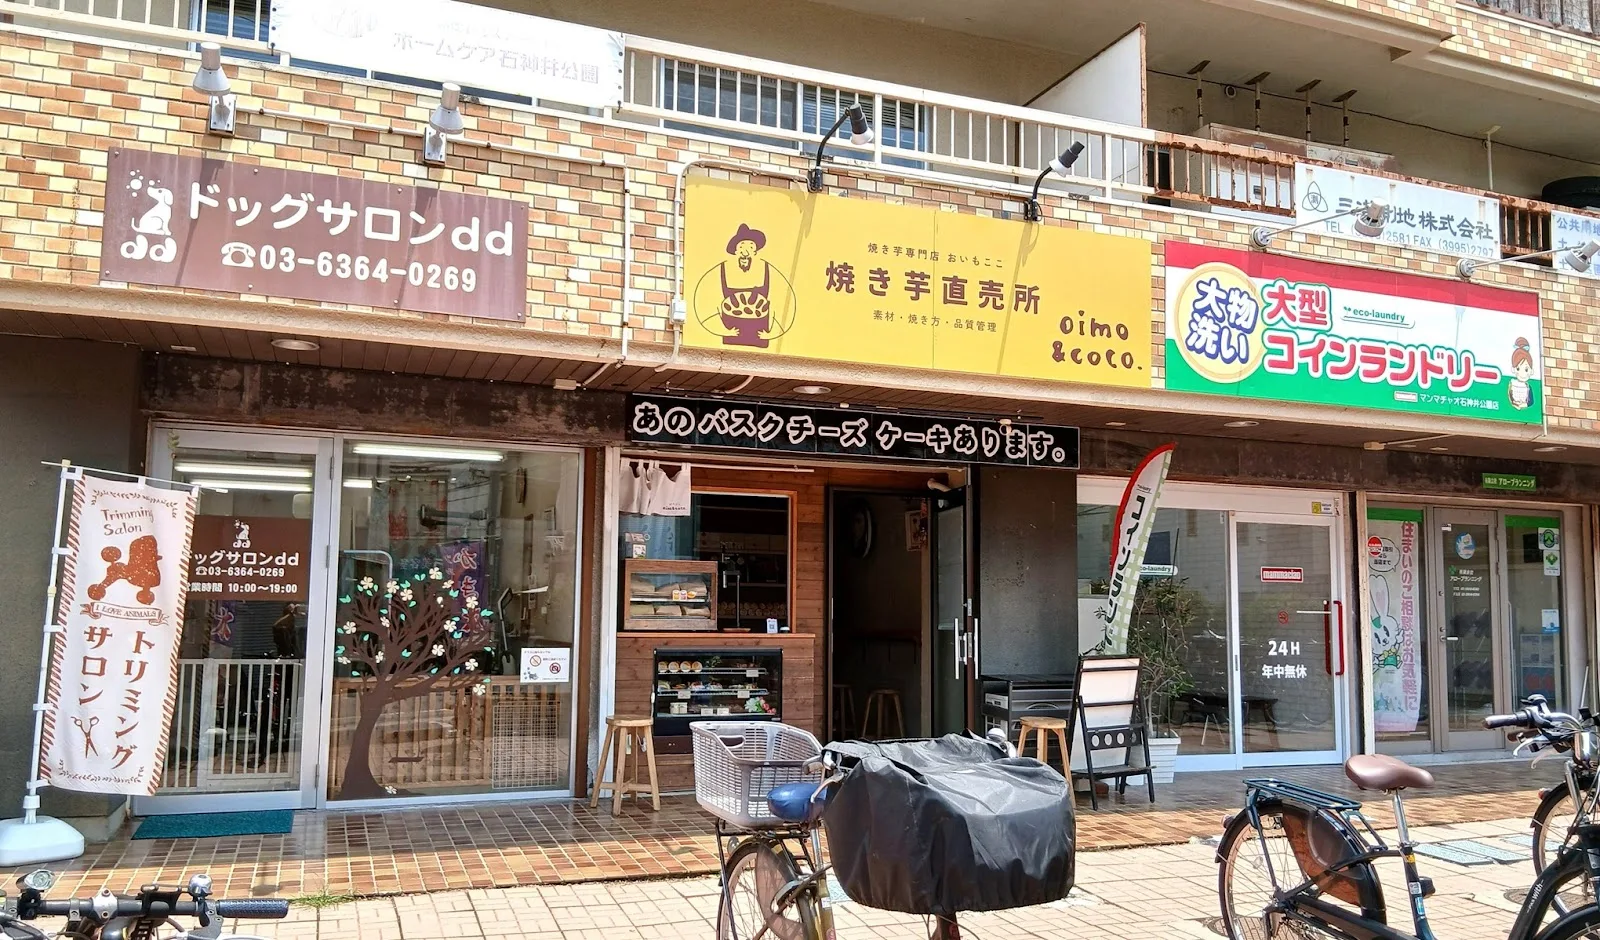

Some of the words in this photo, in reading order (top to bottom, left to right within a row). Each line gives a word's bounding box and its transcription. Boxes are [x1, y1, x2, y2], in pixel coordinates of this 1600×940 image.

[190, 181, 513, 257] ドッグサロンdd
[1325, 219, 1344, 234] TEL
[1413, 234, 1432, 248] FAX
[120, 234, 177, 263] dd
[867, 242, 940, 262] 焼き芋専門店
[948, 252, 1003, 268] おいもここ
[259, 244, 477, 293] 03-6364-0269
[825, 260, 1042, 315] 焼き芋直売所
[1193, 278, 1259, 334] 大物
[1264, 282, 1330, 328] 大型
[1060, 310, 1129, 340] oimo
[1185, 312, 1250, 364] 洗い
[1264, 333, 1501, 389] コインランドリー
[101, 506, 154, 523] Trimming
[103, 522, 142, 536] Salon
[191, 550, 300, 566] ッグサロンdd
[208, 566, 285, 577] 03-6364-0269
[102, 605, 121, 616] LOVE
[123, 609, 157, 618] ANIMALS
[79, 625, 113, 706] サロン
[1261, 664, 1308, 679] 年中無休
[111, 630, 155, 770] トリミング
